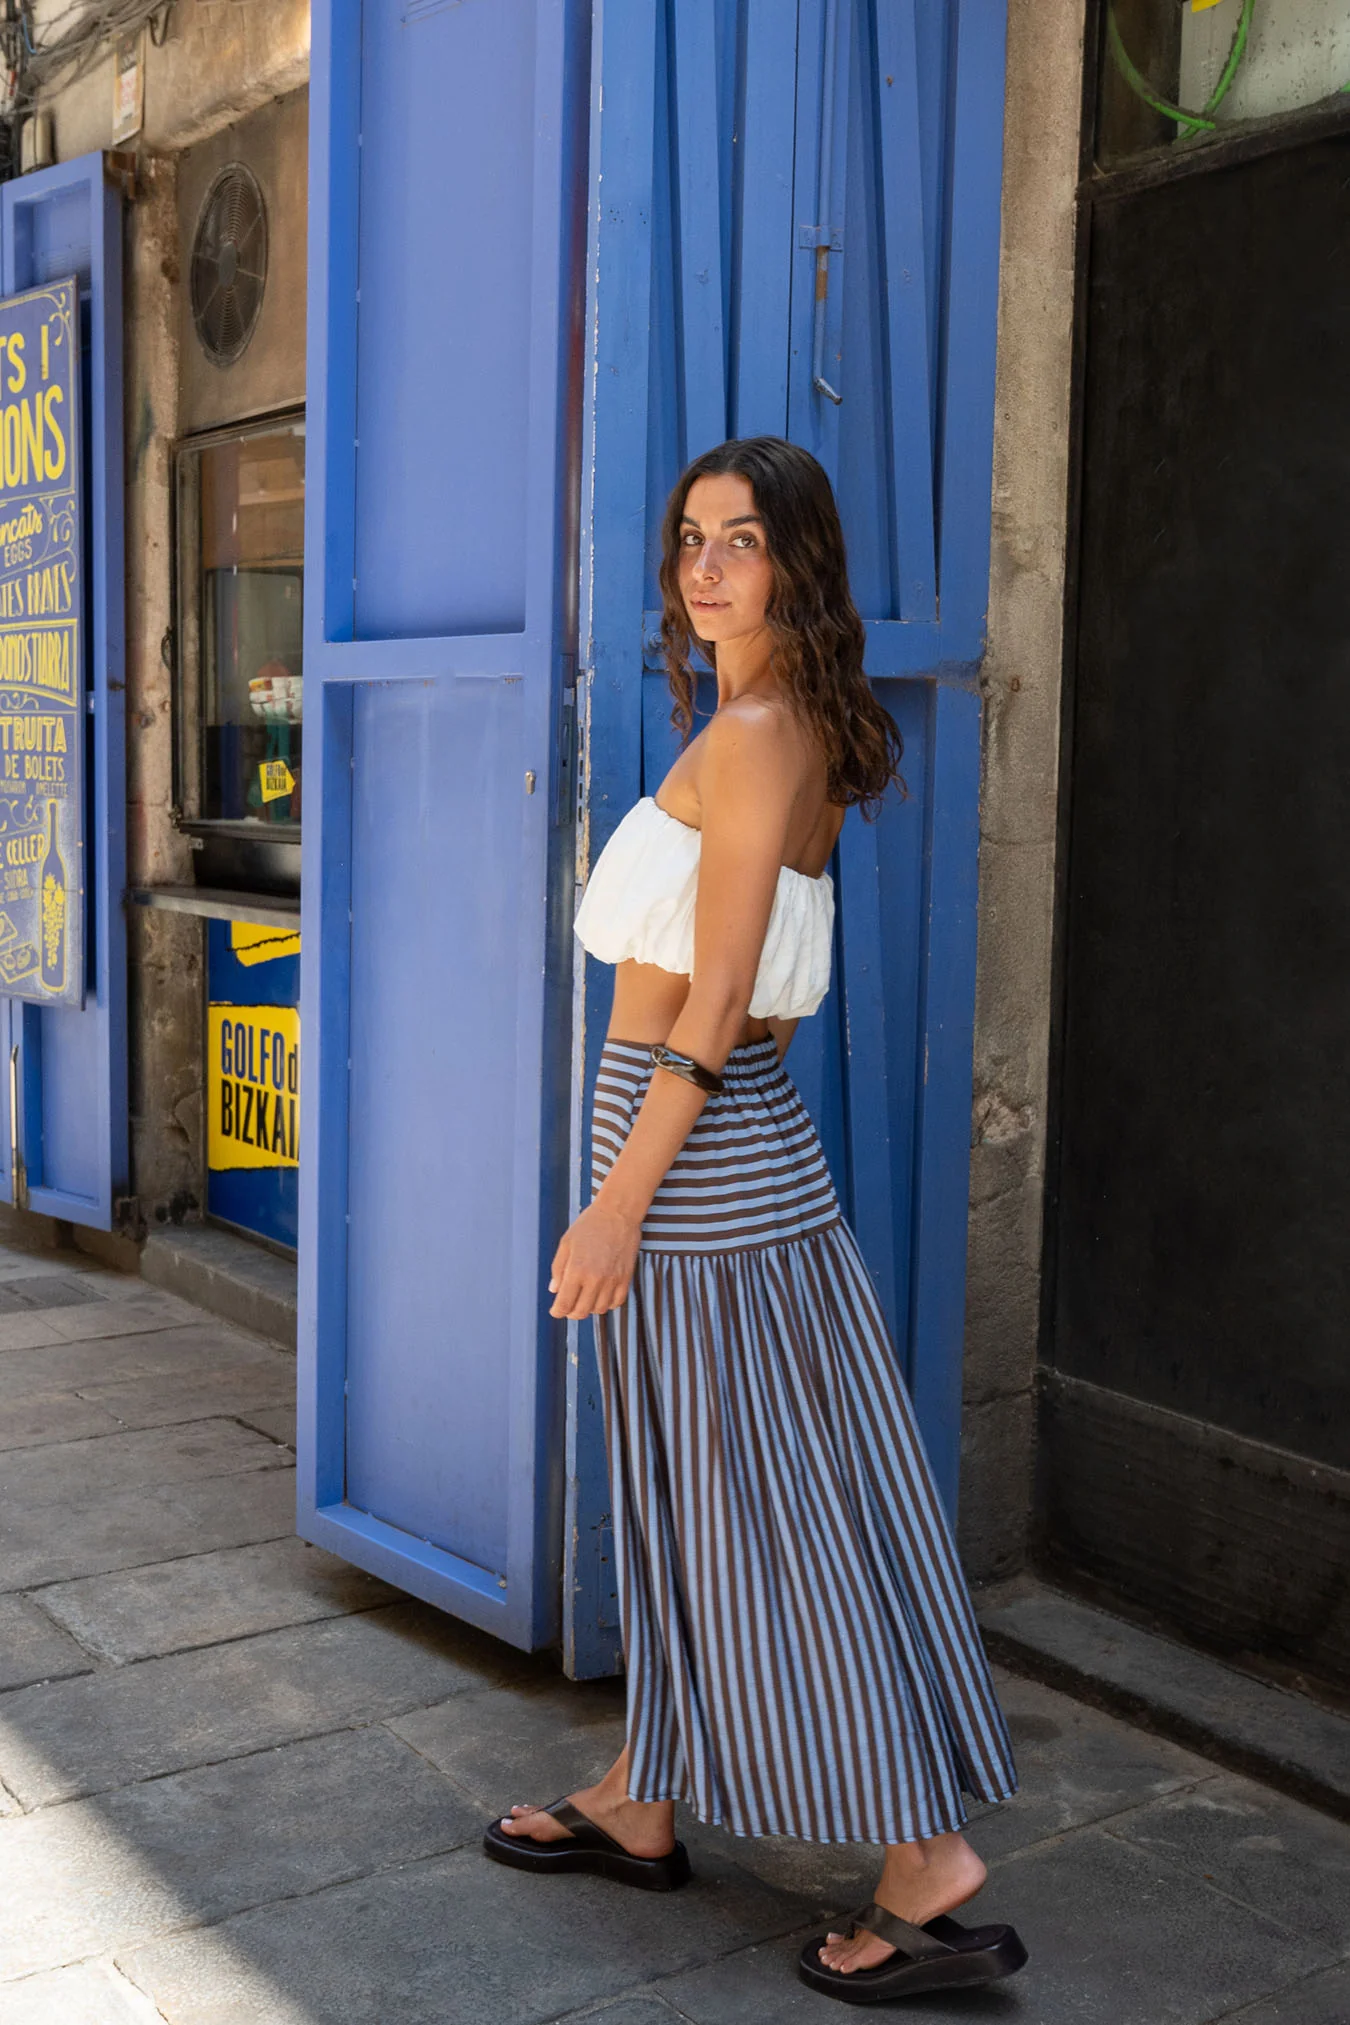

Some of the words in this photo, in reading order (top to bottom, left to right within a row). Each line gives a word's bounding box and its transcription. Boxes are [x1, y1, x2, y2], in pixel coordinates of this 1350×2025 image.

[41, 324, 49, 380] I
[4, 538, 33, 568] EGGS
[0, 578, 24, 618] TES
[0, 715, 67, 753] TRUITA
[4, 754, 20, 779] DE
[25, 754, 65, 781] BOLETS
[221, 1019, 285, 1090] GOLFO
[288, 1044, 299, 1095] d
[221, 1078, 299, 1161] BIZKAI
